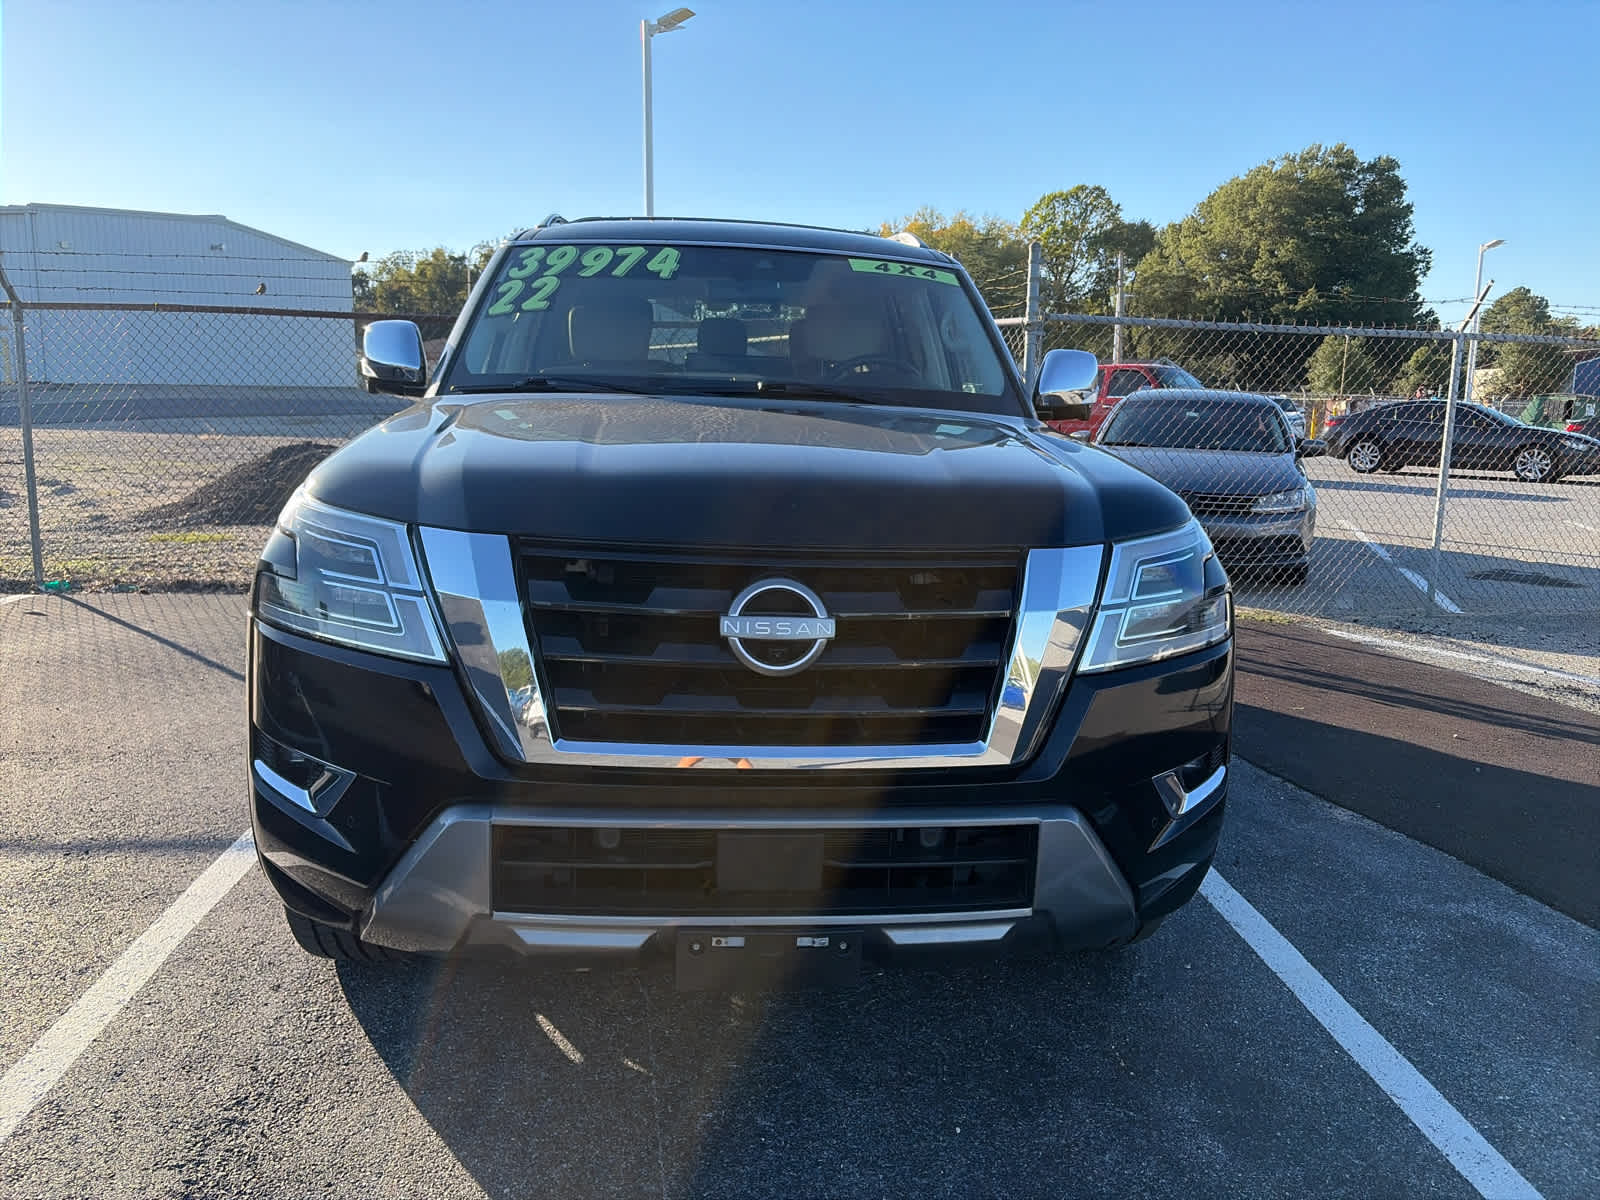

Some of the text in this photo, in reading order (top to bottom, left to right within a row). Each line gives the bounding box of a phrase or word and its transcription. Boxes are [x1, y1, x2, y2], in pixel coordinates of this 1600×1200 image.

[508, 246, 681, 279] 39974
[488, 275, 561, 316] 22
[723, 620, 832, 635] NISSAN
